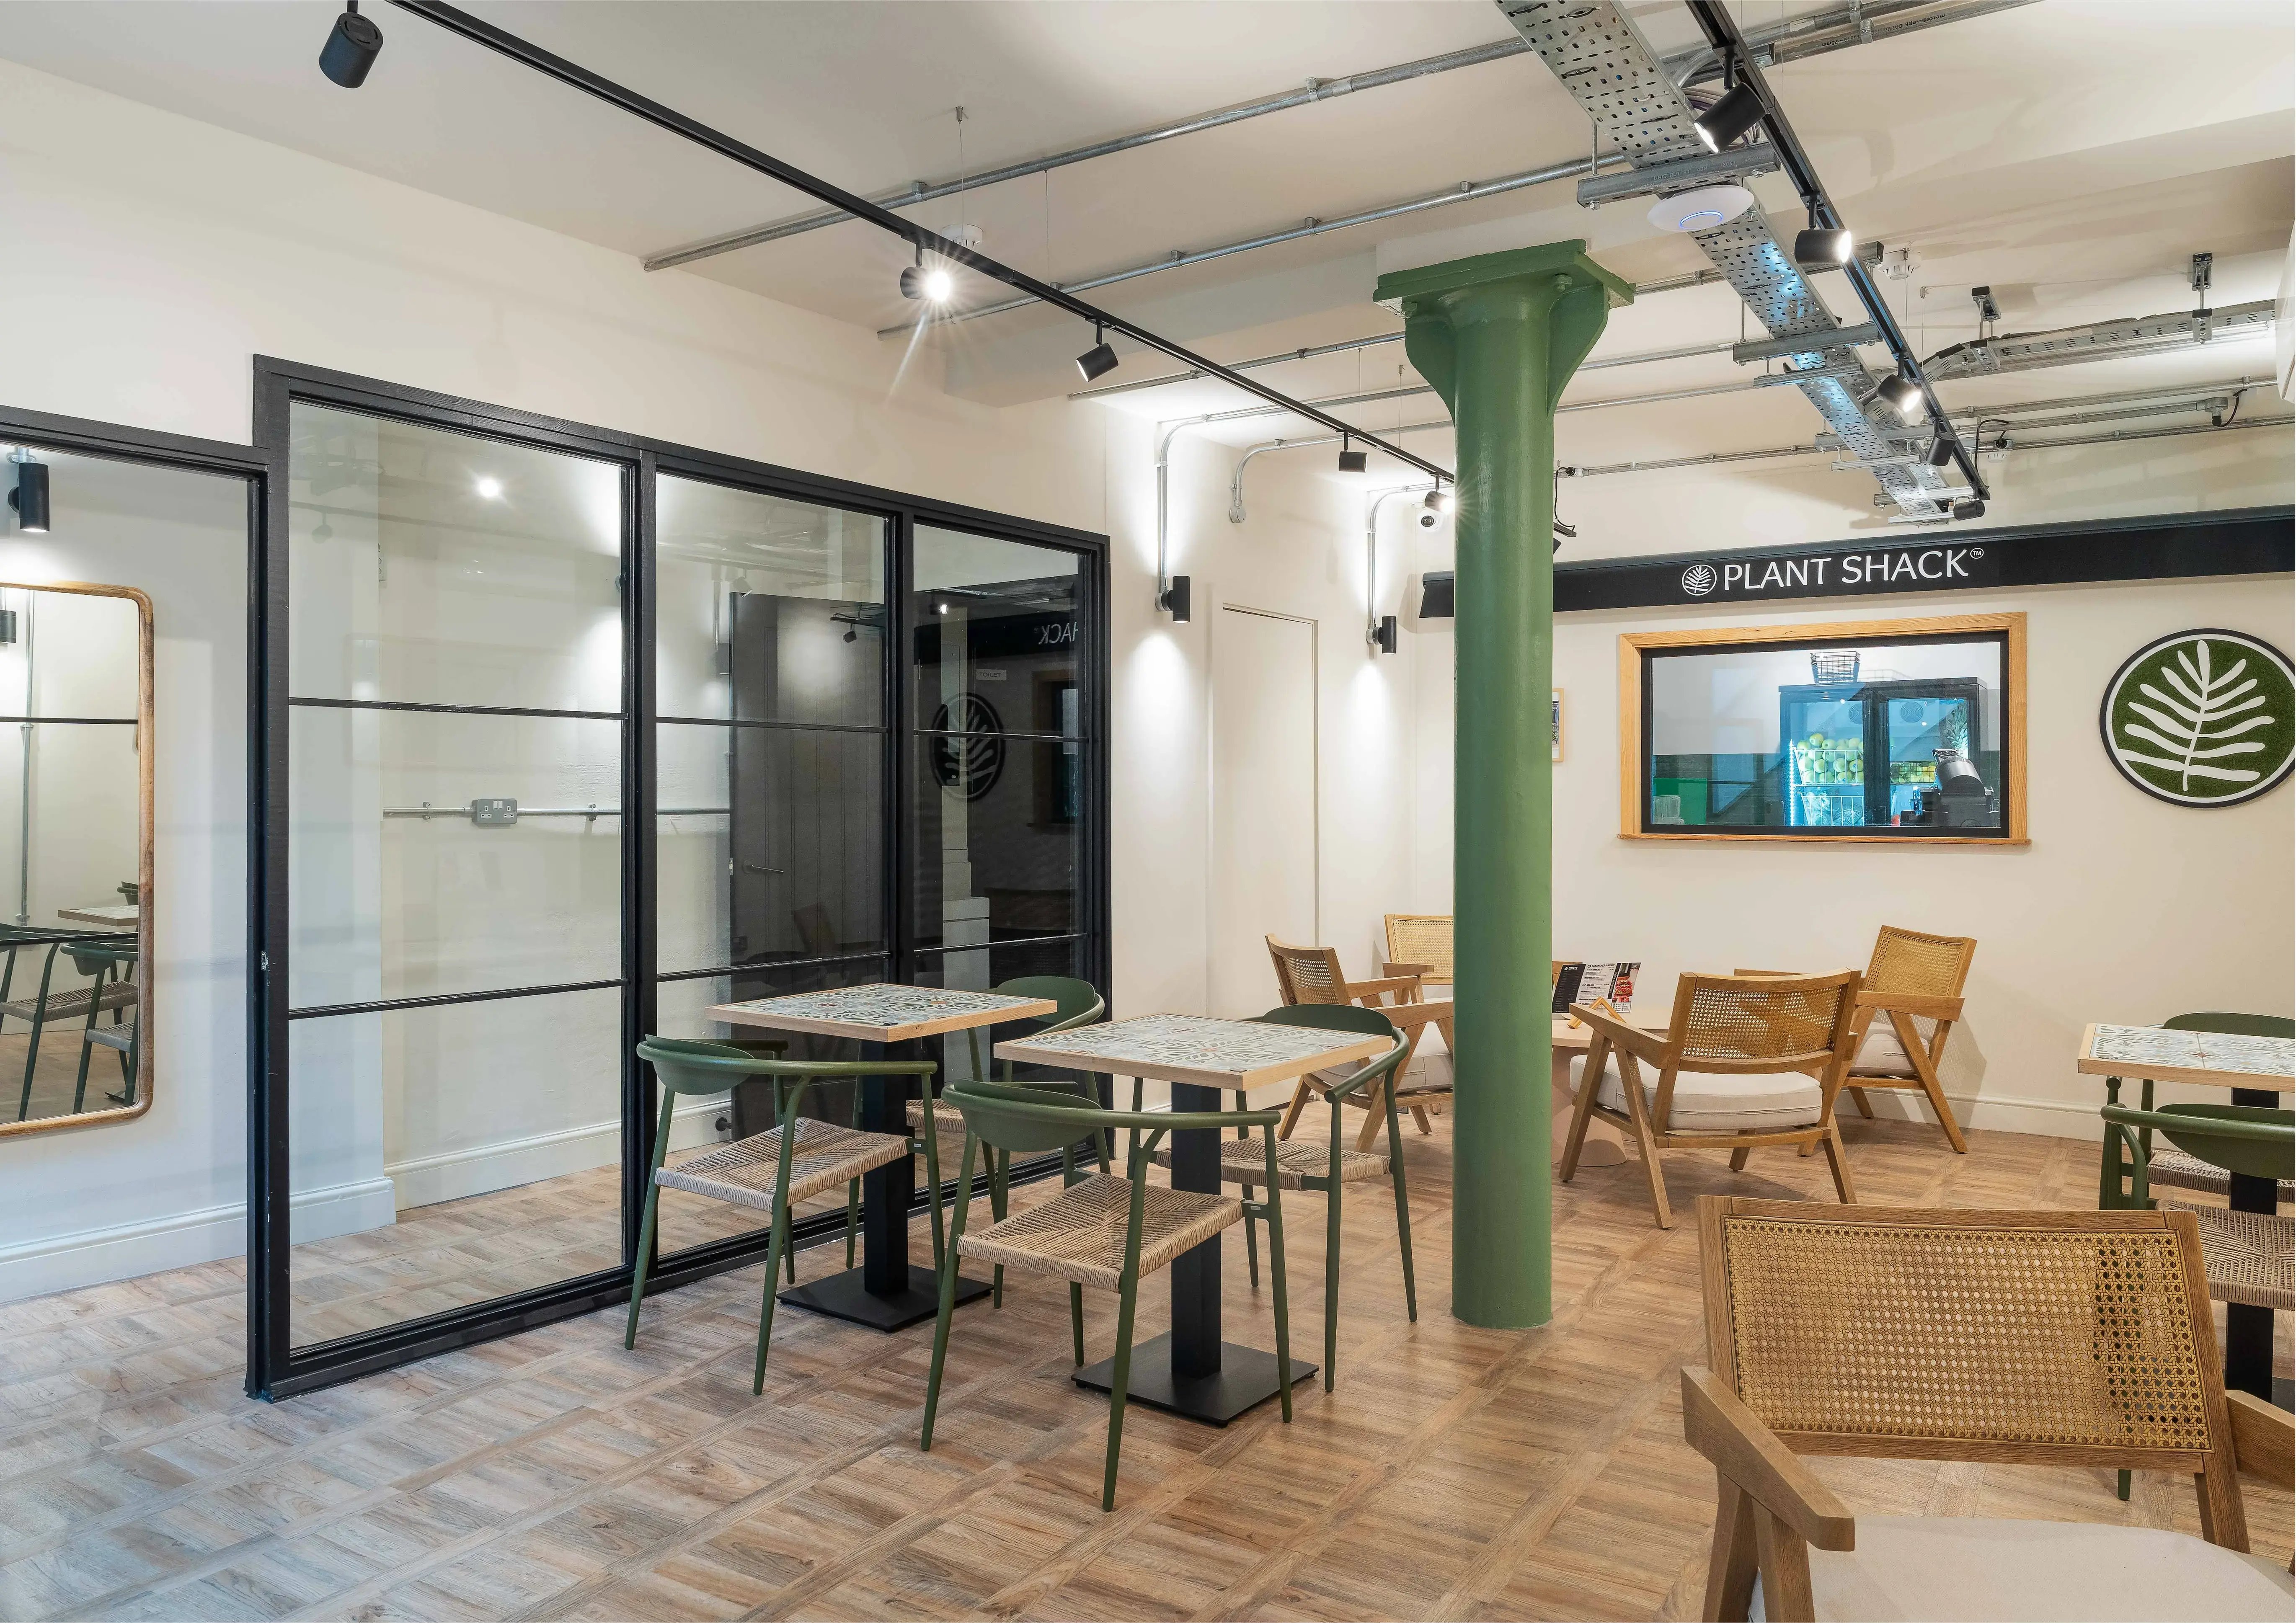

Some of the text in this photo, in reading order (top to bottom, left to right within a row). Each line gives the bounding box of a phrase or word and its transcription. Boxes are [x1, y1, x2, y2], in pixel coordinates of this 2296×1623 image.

[1653, 171, 1680, 180] UNISTRUT
[1725, 558, 1831, 591] PLANT
[1841, 549, 1968, 583] SHACK
